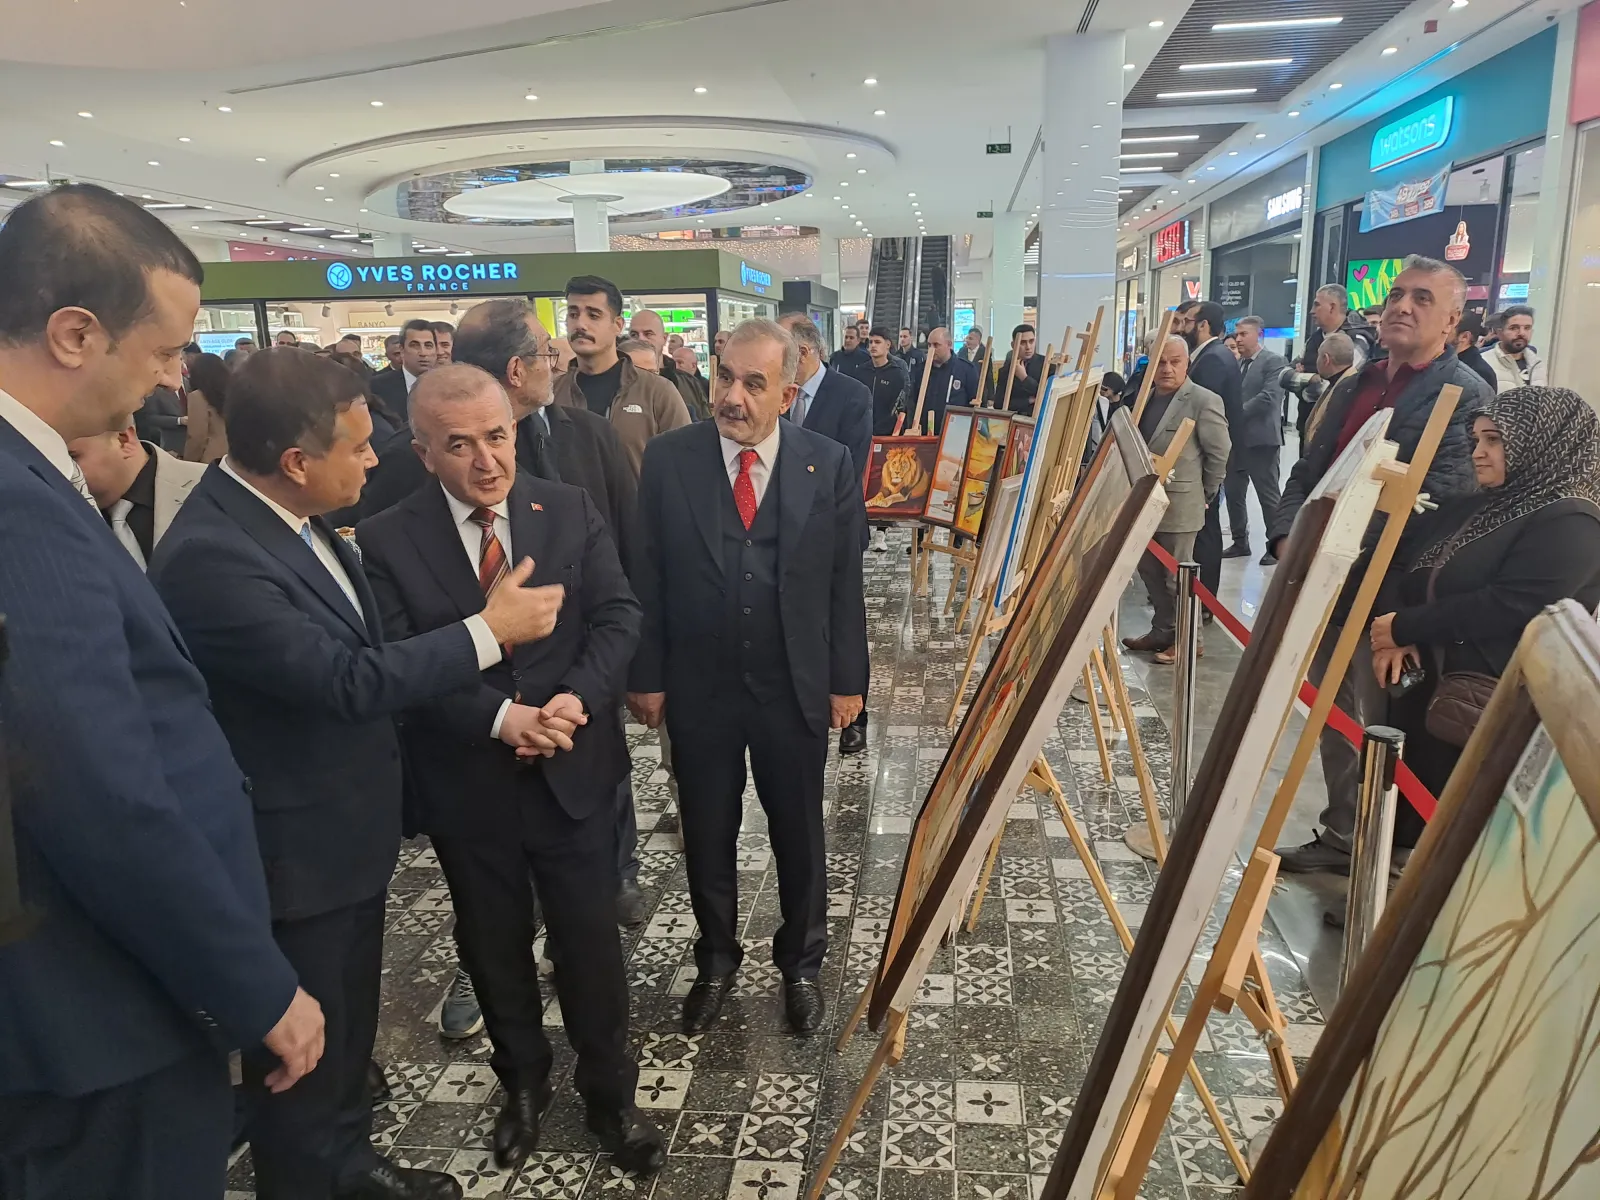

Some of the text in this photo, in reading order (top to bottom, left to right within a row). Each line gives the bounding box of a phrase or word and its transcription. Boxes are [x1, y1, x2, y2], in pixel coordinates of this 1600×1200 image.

[1379, 113, 1437, 157] watsons
[356, 262, 517, 282] YVES ROCHER
[407, 282, 469, 292] FRANCE
